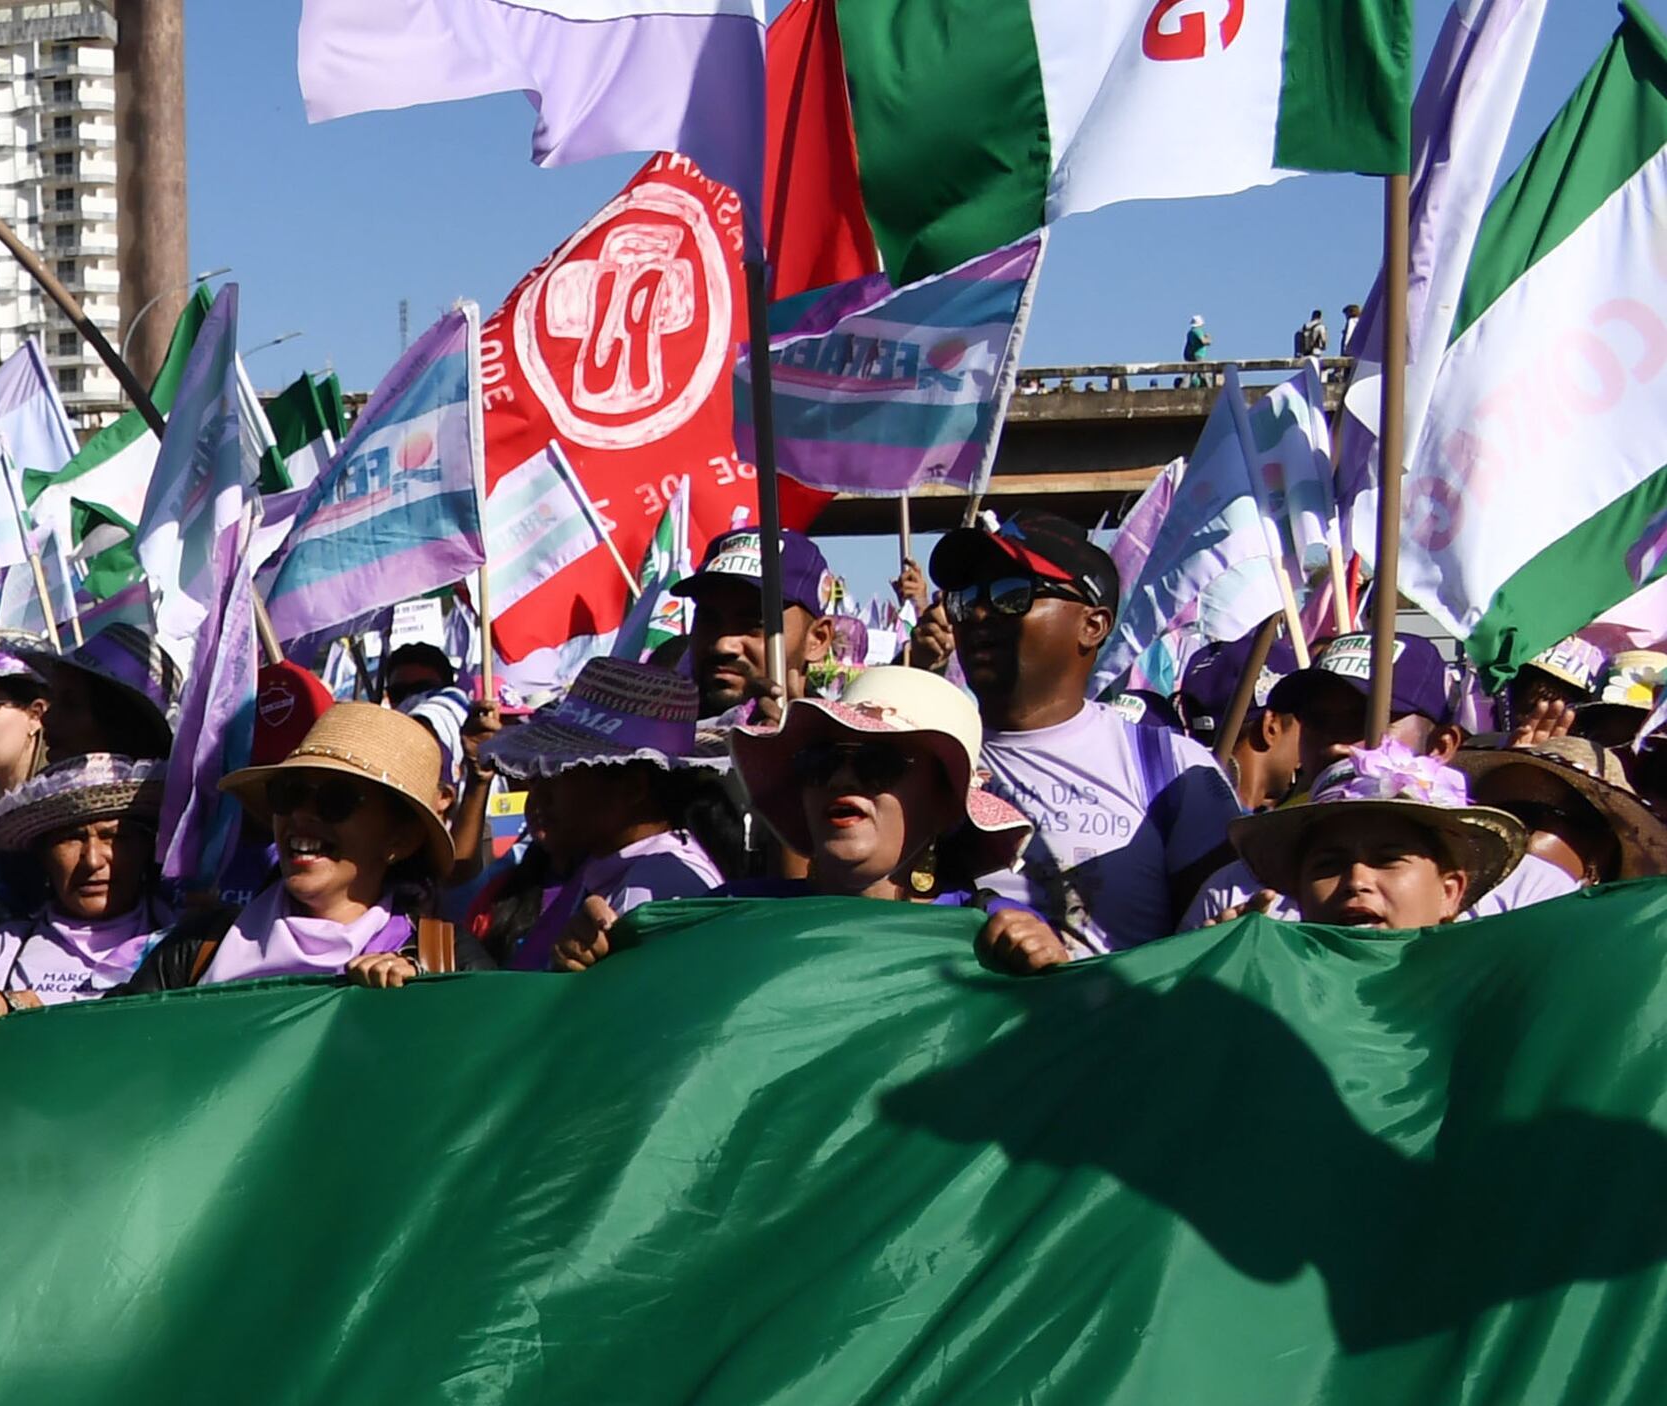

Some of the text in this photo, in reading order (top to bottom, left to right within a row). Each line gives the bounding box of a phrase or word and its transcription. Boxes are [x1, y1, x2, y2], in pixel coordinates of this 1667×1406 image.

[717, 555, 762, 573] STTR
[1324, 655, 1370, 675] STTR
[1051, 783, 1099, 806] DAS
[1078, 812, 1131, 838] 2019
[42, 972, 93, 983] MARC
